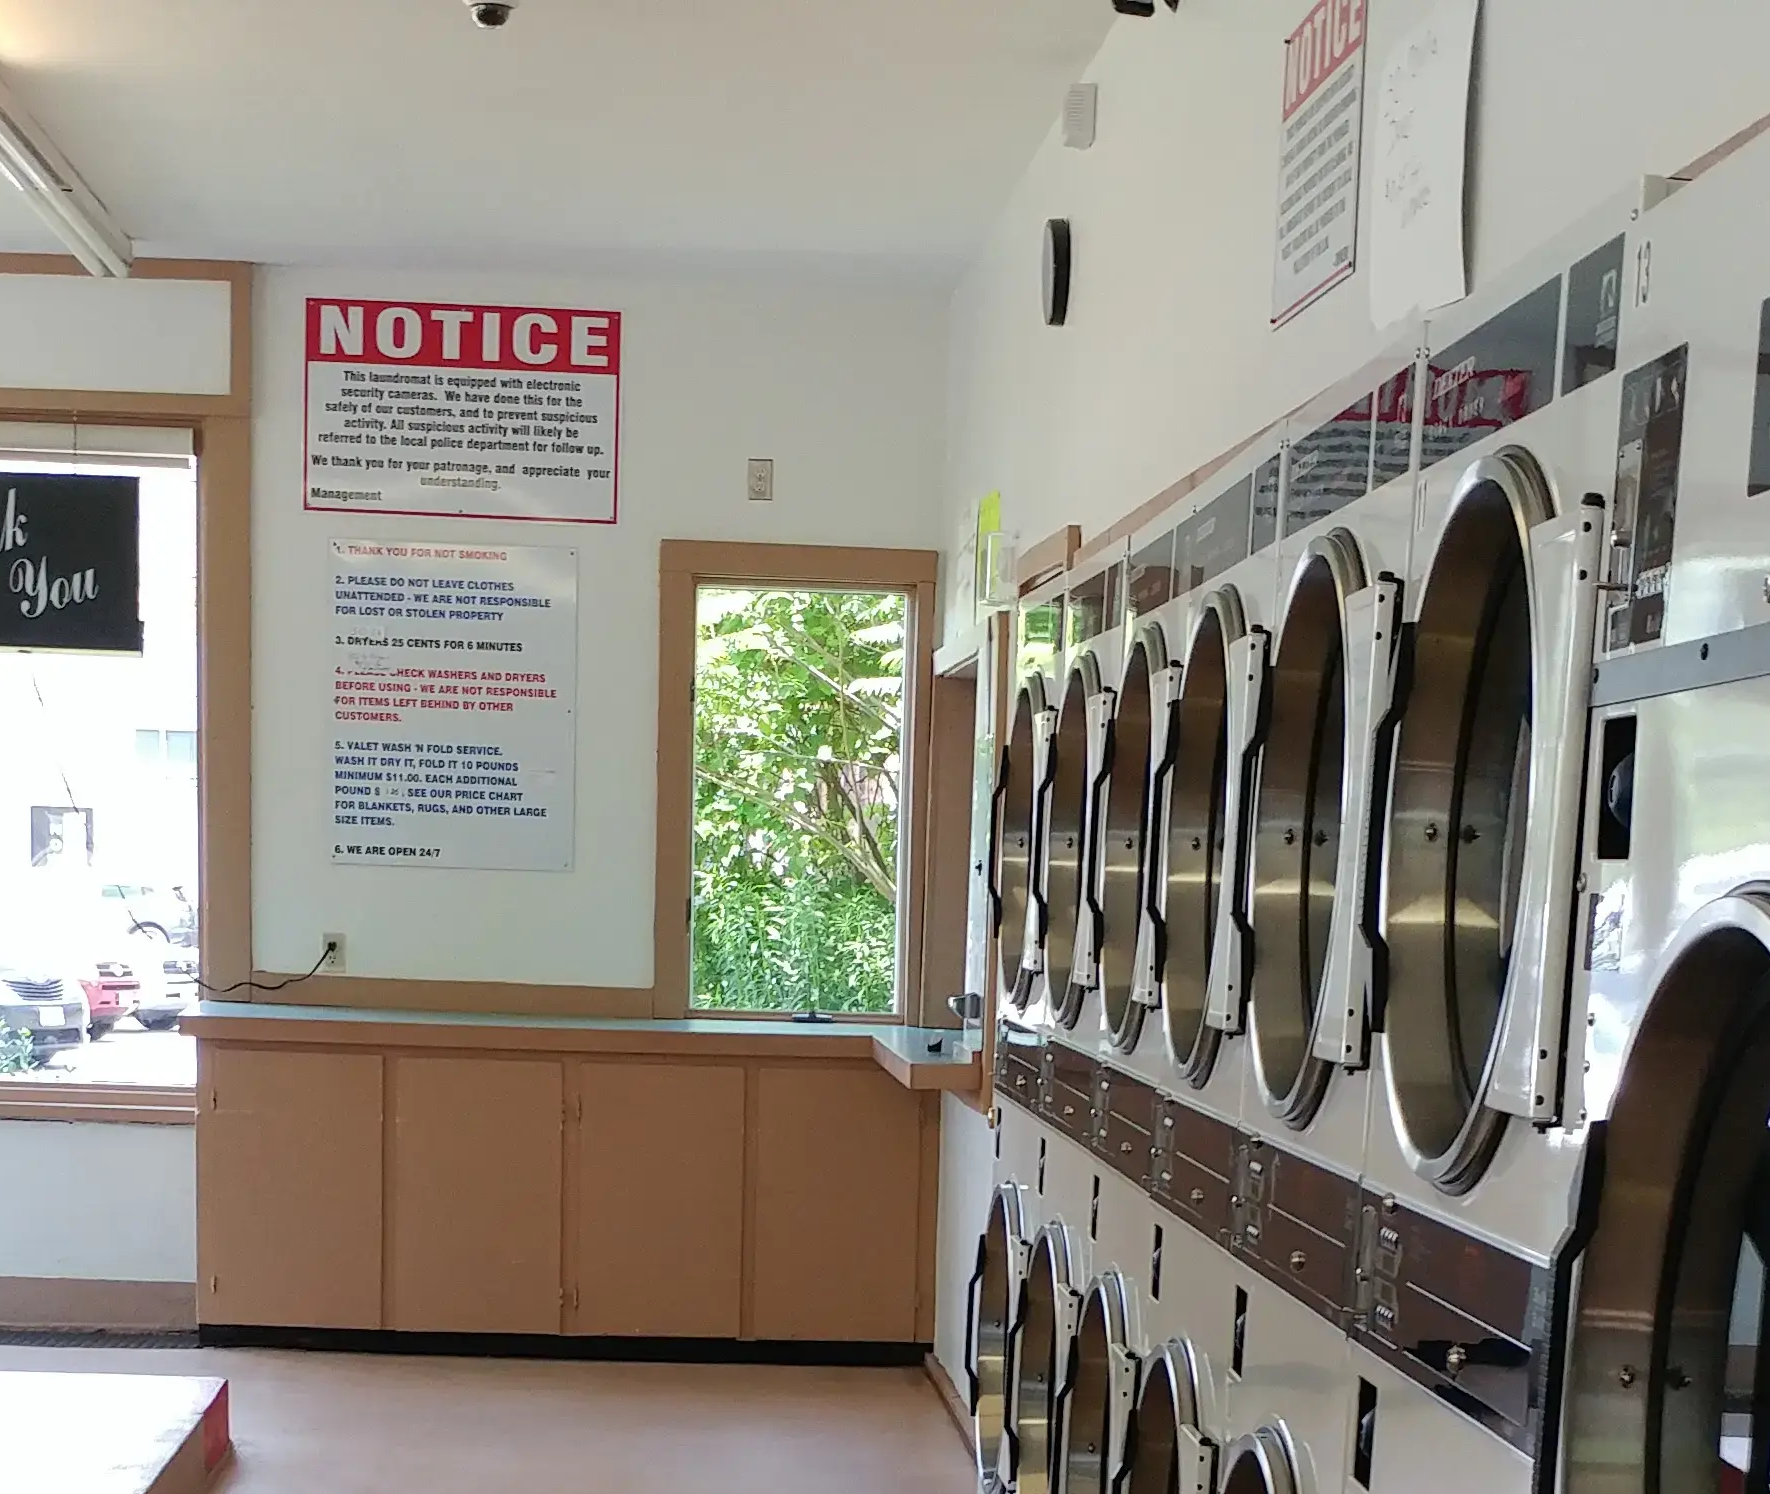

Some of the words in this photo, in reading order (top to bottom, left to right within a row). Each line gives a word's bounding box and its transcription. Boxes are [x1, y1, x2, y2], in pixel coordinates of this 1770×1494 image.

[1285, 0, 1361, 111] NOTICE
[319, 304, 610, 367] NOTICE
[342, 370, 367, 383] This
[368, 371, 432, 386] laundromat
[433, 373, 445, 386] is
[446, 375, 497, 390] equipped
[499, 377, 524, 390] with
[526, 379, 582, 392] electronic
[340, 386, 385, 401] security
[387, 390, 439, 401] cameras.
[443, 390, 462, 402] We
[464, 391, 491, 404] have
[493, 392, 521, 405] done
[522, 394, 544, 406] this
[546, 395, 563, 407] for
[564, 396, 583, 408] the
[360, 402, 373, 414] of
[375, 404, 394, 415] our
[396, 404, 457, 418] customers,
[458, 407, 480, 419] and
[482, 407, 494, 419] to
[496, 410, 539, 422] prevent
[540, 411, 599, 425] suspicious
[343, 417, 387, 432] activity.
[389, 418, 405, 431] All
[407, 420, 466, 435] suspicious
[467, 423, 509, 438] activity
[511, 424, 531, 437] will
[533, 425, 563, 441] likely
[565, 426, 580, 439] be
[317, 432, 363, 444] referred
[365, 433, 377, 445] to
[379, 434, 398, 446] the
[399, 435, 428, 447] local
[430, 437, 464, 450] police
[466, 438, 530, 452] department
[532, 441, 549, 453] for
[550, 442, 585, 454] follow
[586, 445, 605, 457] up.
[310, 454, 329, 466] We
[330, 455, 363, 468] thank
[364, 458, 385, 471] you
[387, 457, 404, 470] for
[405, 460, 431, 473] your
[432, 460, 493, 476] patronage,
[494, 463, 516, 475] and
[521, 465, 581, 479] appreciate
[586, 469, 612, 481] your
[310, 488, 383, 503] Management
[347, 545, 384, 556] THANK
[385, 546, 408, 557] YOU
[410, 547, 432, 558] FOR
[434, 549, 456, 559] NOT
[458, 549, 508, 562] SMOKING
[9, 555, 100, 619] You
[335, 574, 346, 585] 2.
[347, 575, 388, 587] PLEASE
[389, 577, 406, 588] DO
[407, 578, 430, 589] NOT
[431, 579, 465, 590] LEAVE
[466, 580, 515, 592] CLOTHES
[335, 590, 406, 602] UNATTENDED
[412, 593, 430, 604] WE
[431, 594, 453, 605] ARE
[455, 595, 478, 605] NOT
[479, 596, 552, 609] RESPONSIBLE
[335, 605, 357, 616] FOR
[358, 605, 386, 617] LOST
[387, 607, 404, 618] OR
[405, 608, 447, 619] STOLEN
[448, 609, 505, 622] PROPERTY
[334, 635, 346, 645] 3.
[390, 637, 405, 648] 25
[406, 638, 441, 649] CENTS
[443, 639, 465, 650] FOR
[475, 641, 523, 653] MINUTES
[334, 665, 345, 675] 4.
[427, 669, 478, 681] WASHERS
[480, 671, 503, 682] AND
[504, 672, 546, 684] DRYERS
[334, 680, 377, 692] BEFORE
[378, 682, 412, 693] USING
[419, 683, 436, 694] WE
[437, 684, 460, 695] ARE
[461, 685, 484, 696] NOT
[485, 686, 558, 699] RESPONSIBLE
[334, 695, 356, 706] FOR
[358, 696, 391, 707] ITEMS
[392, 697, 419, 708] LEFT
[420, 699, 460, 710] BEHIND
[462, 700, 477, 711] BY
[478, 701, 514, 712] OTHER
[334, 710, 402, 723] CUSTOMERS.
[334, 740, 345, 750] 5.
[346, 740, 380, 752] VALET
[381, 742, 412, 753] WASH
[426, 743, 454, 754] FOLD
[455, 745, 504, 757] SERVICE.
[334, 755, 365, 766] WASH
[367, 756, 378, 767] IT
[379, 757, 402, 768] DRY
[403, 757, 416, 770] IT,
[418, 758, 446, 769] FOLD
[447, 759, 459, 770] IT
[461, 760, 474, 770] 10
[475, 760, 519, 772] POUNDS
[334, 770, 384, 781] MINIMUM
[385, 771, 423, 783] $11.00.
[424, 773, 454, 784] EACH
[455, 775, 518, 787] ADDITIONAL
[334, 784, 372, 796] POUND
[407, 787, 428, 798] SEE
[429, 788, 453, 799] OUR
[454, 789, 486, 801] PRICE
[488, 791, 524, 802] CHART
[334, 799, 356, 810] FOR
[357, 800, 415, 814] BLANKETS,
[417, 803, 450, 816] RUGS,
[451, 804, 474, 815] AND
[475, 805, 511, 816] OTHER
[513, 806, 548, 818] LARGE
[334, 814, 359, 825] SIZE
[360, 815, 395, 827] ITEMS.
[334, 844, 345, 854] 6.
[346, 844, 363, 855] WE
[364, 845, 386, 856] ARE
[387, 846, 417, 857] OPEN
[418, 847, 441, 858] 24/7
